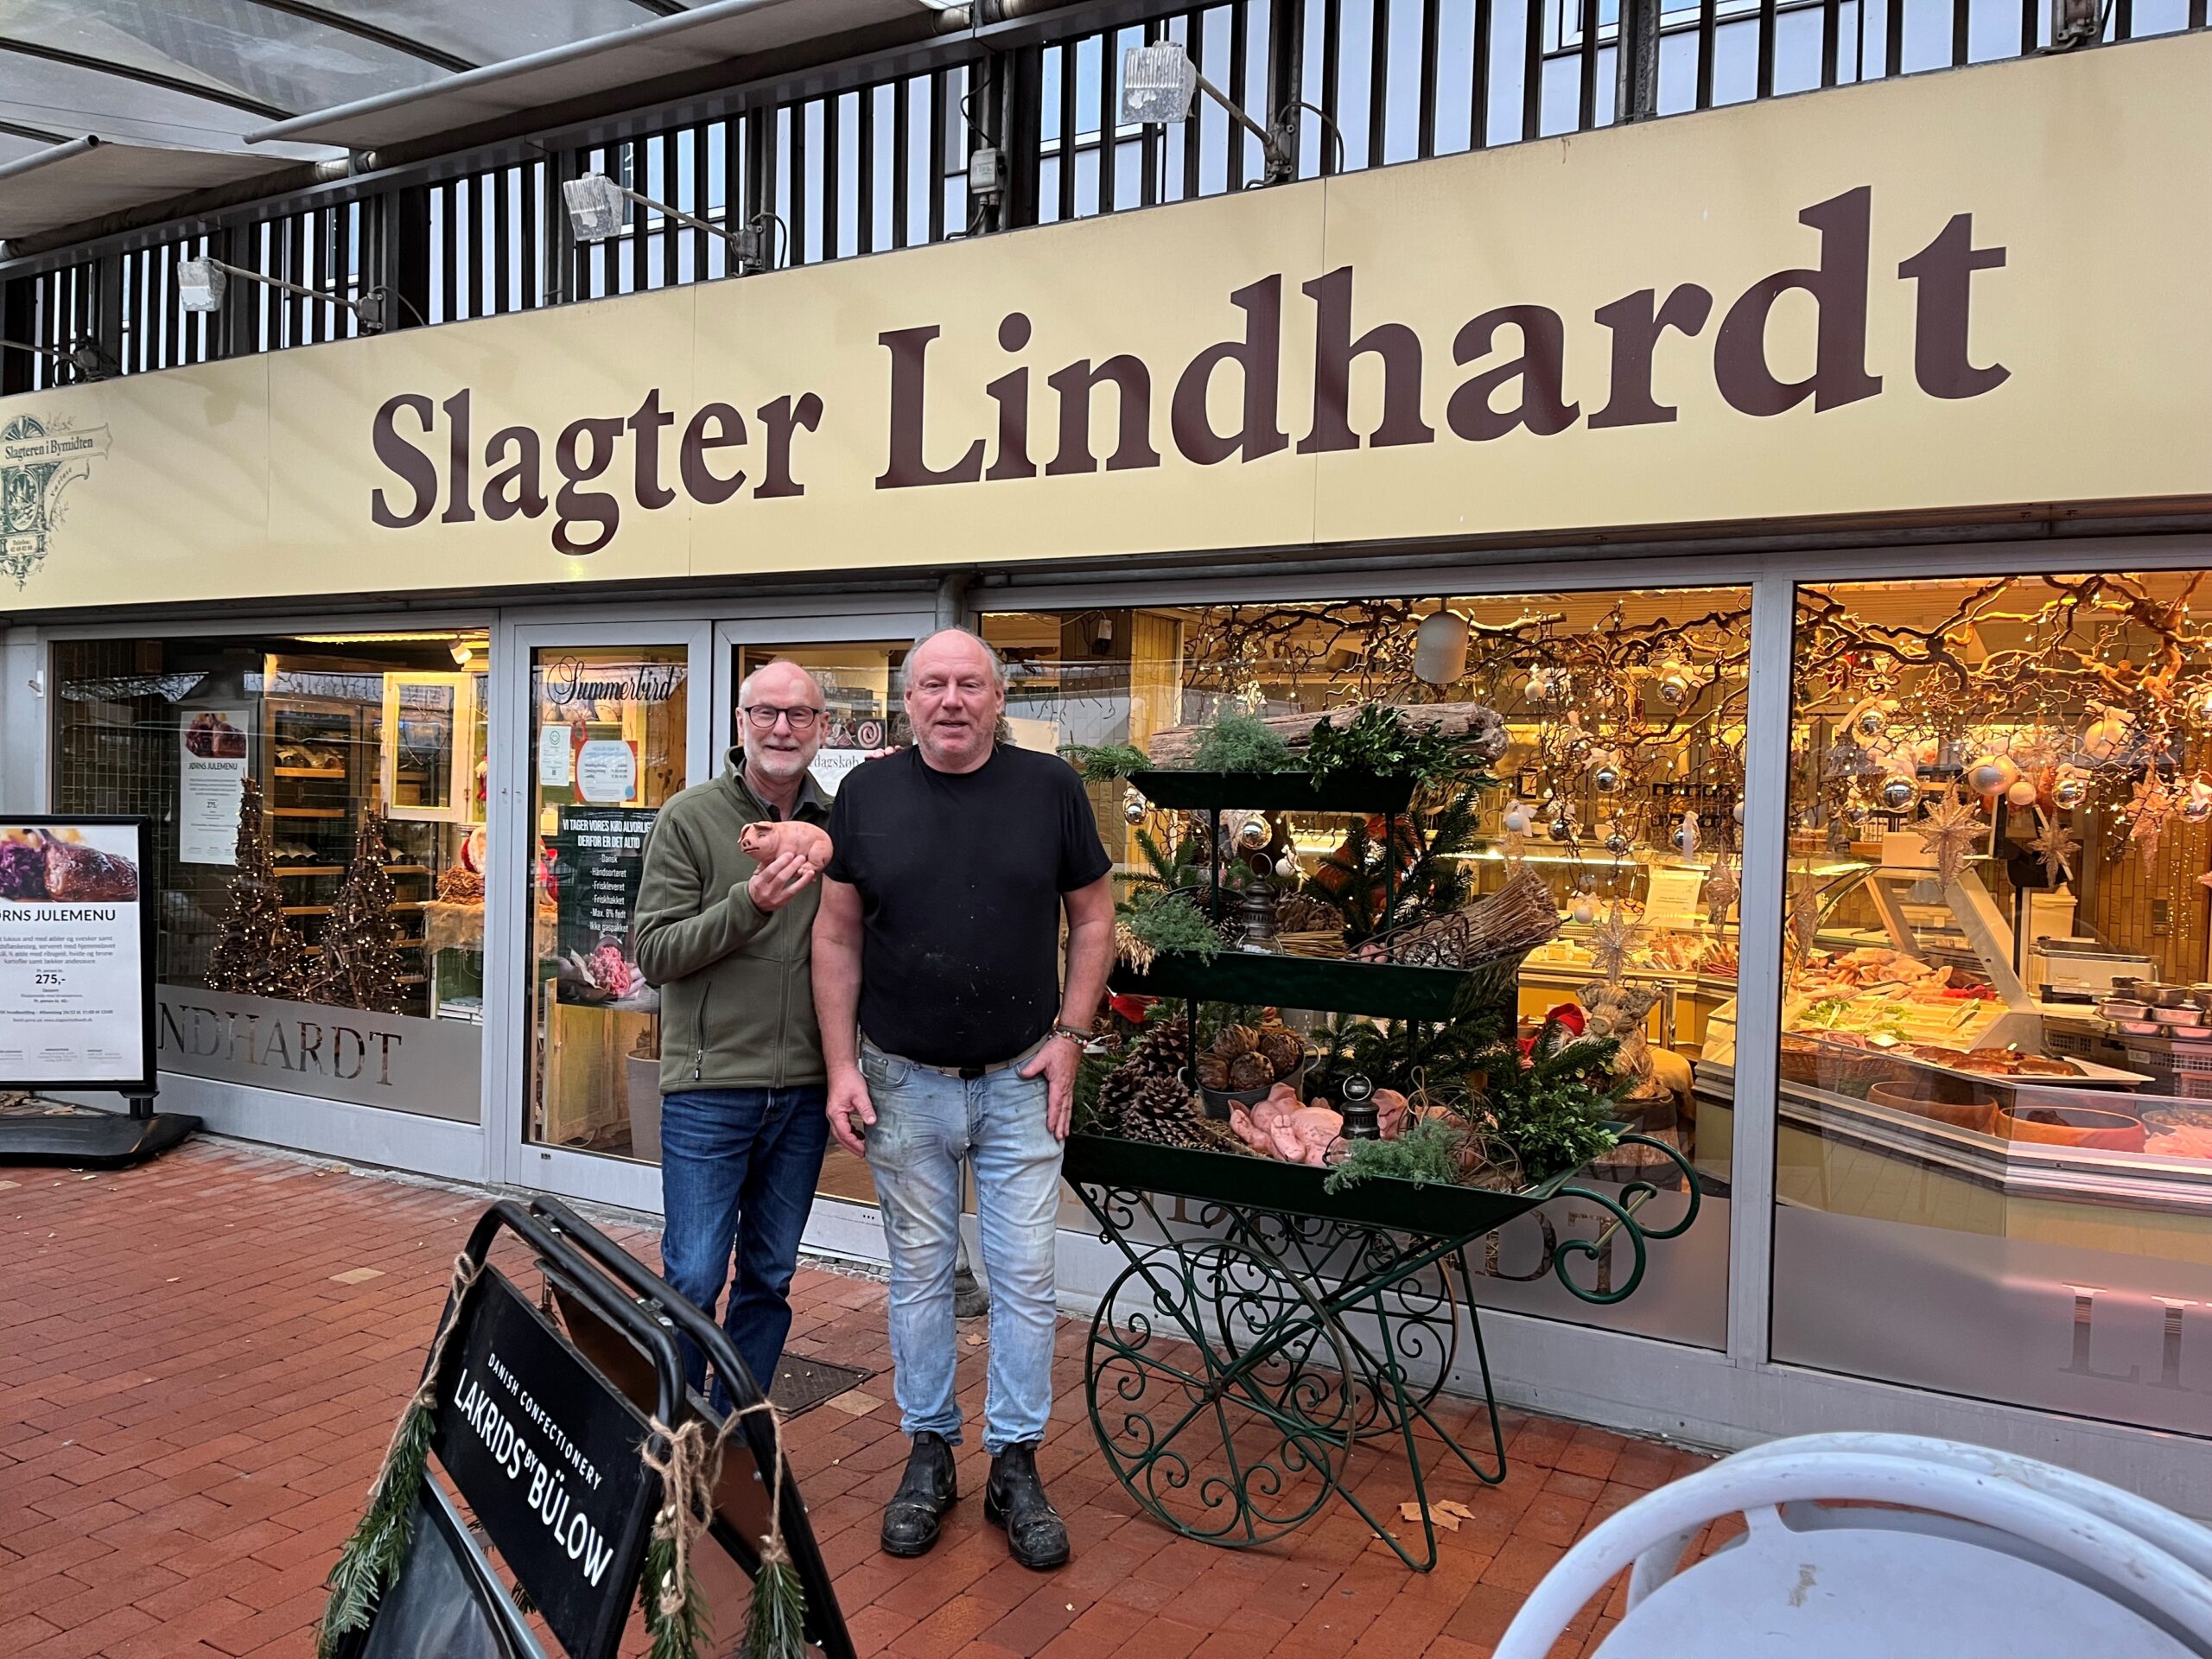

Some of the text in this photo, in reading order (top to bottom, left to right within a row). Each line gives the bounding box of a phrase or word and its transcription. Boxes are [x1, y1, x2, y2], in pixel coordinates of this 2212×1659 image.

[372, 185, 2012, 556] Slagter Lindhardt
[5, 436, 93, 461] Slagteren i Bymidten
[547, 655, 675, 705] Summerbird
[207, 762, 238, 771] JULEMENU
[808, 753, 860, 769] dagskøb
[563, 818, 655, 834] VI TAGER VORES KØD ALVORLIG
[577, 835, 640, 849] DERFOR ER DET ALTID
[0, 909, 116, 922] RNS JULEMENU
[35, 974, 66, 985] 275,-
[157, 1002, 402, 1086] NDHARDT
[2057, 1281, 2212, 1394] LI
[487, 1352, 603, 1491] DANISH CONFECTIONERY
[454, 1368, 613, 1588] LAKRIDS BY BÜLOW
